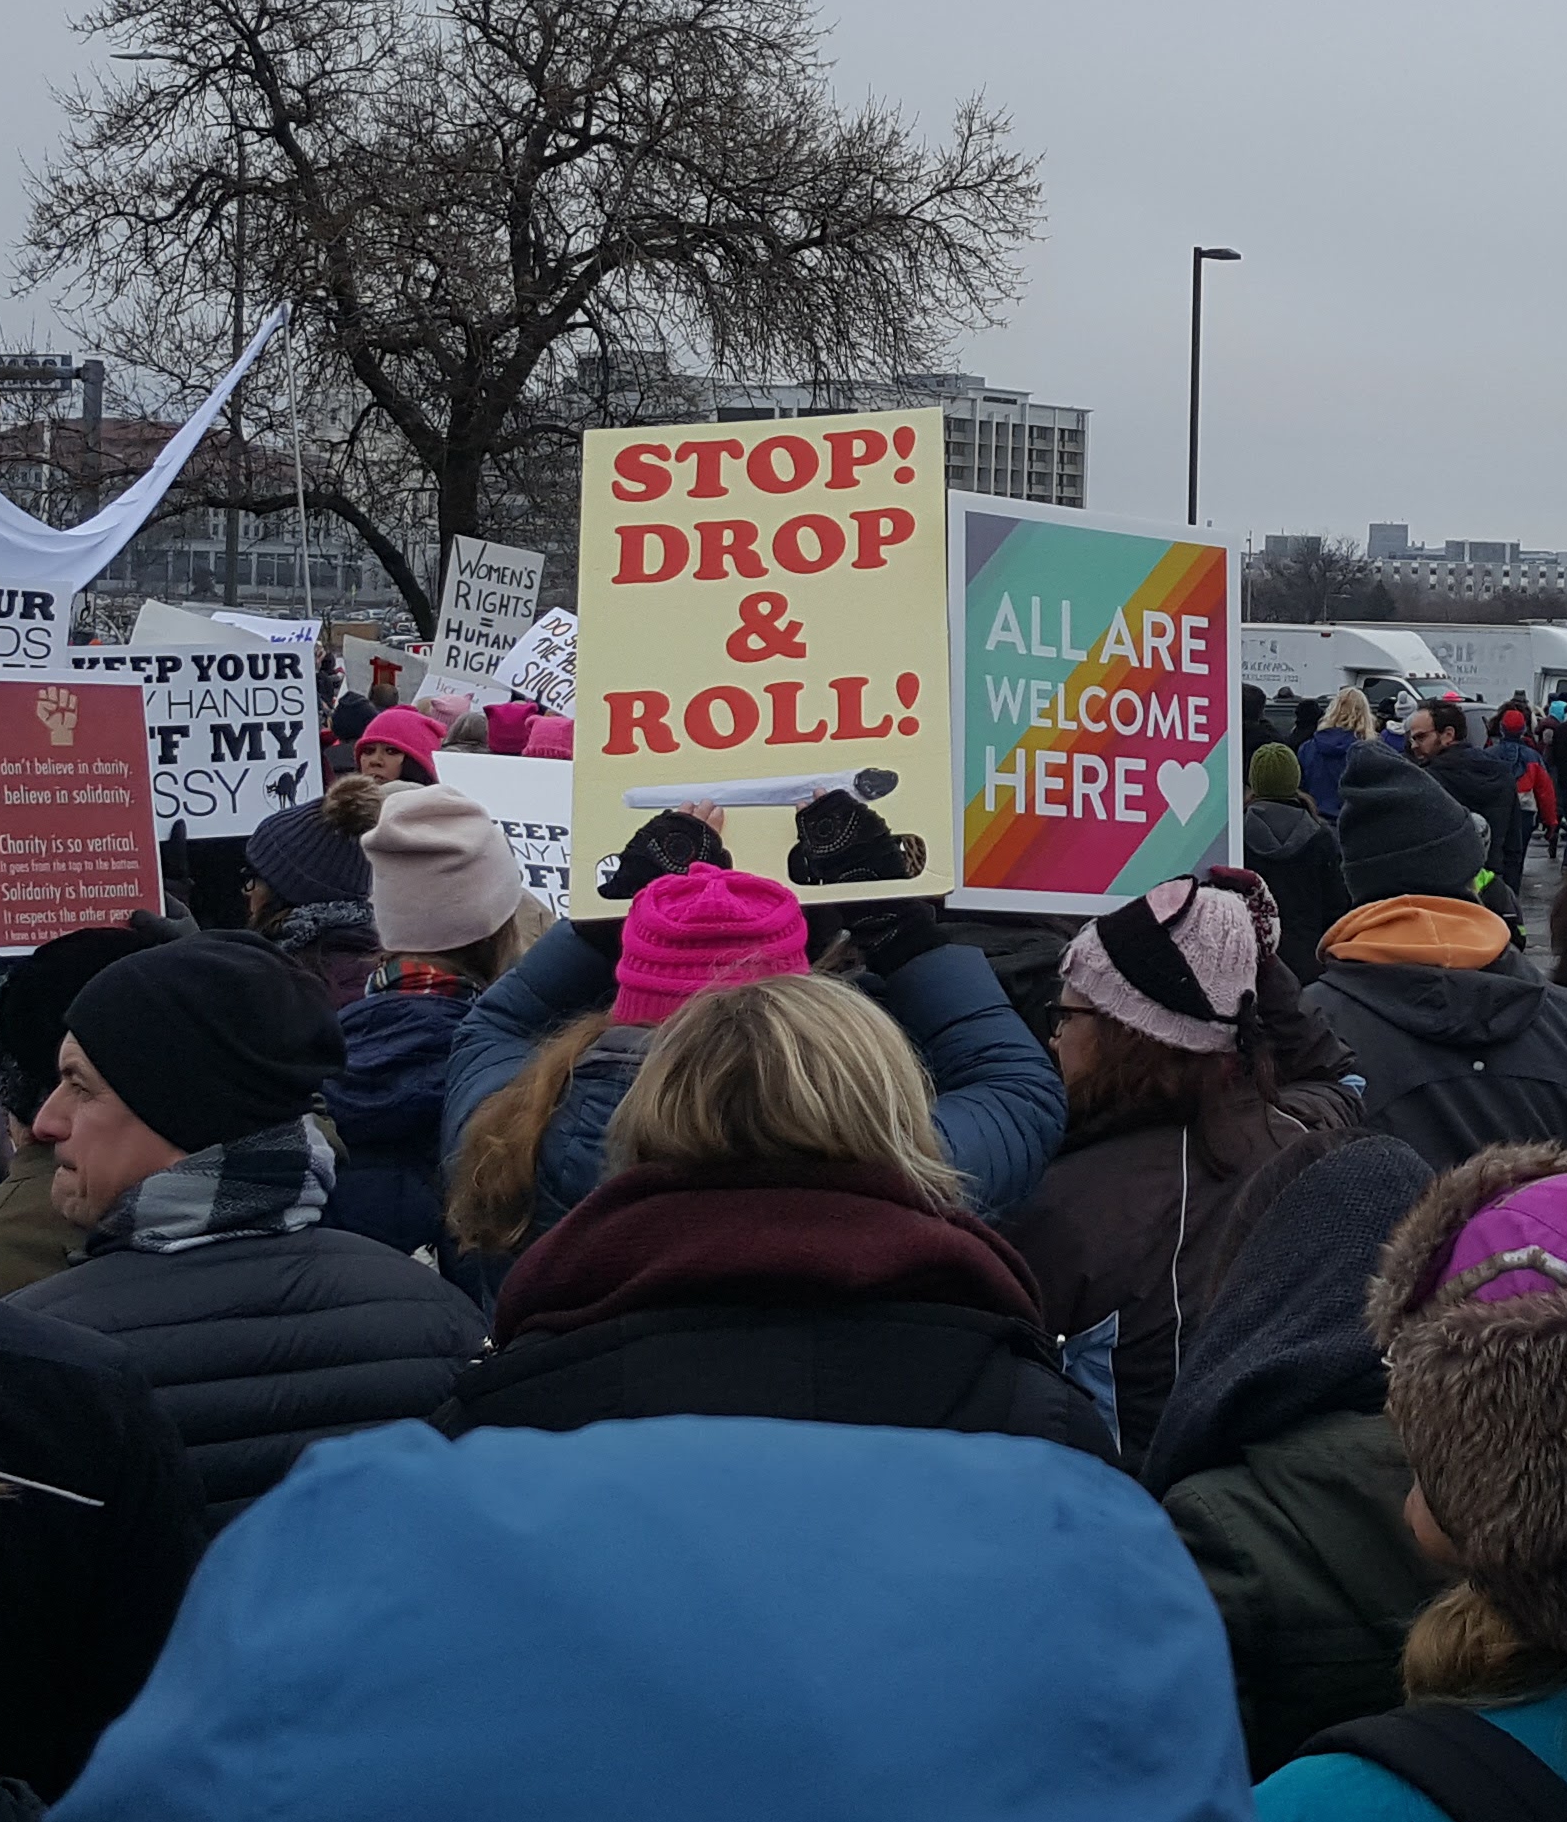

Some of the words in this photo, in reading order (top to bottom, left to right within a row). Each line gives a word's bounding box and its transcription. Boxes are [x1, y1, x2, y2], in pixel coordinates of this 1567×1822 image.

[612, 426, 916, 502] STOP!
[612, 507, 915, 584] DROP
[454, 536, 537, 590] WOMEN'S
[454, 579, 533, 618] RIGHTS
[445, 617, 517, 650] HUMAN
[540, 616, 573, 638] DO
[725, 591, 807, 663] &
[985, 591, 1087, 661] ALL
[1099, 606, 1209, 675] ARE
[445, 645, 505, 676] RIGH
[532, 637, 566, 663] THE
[191, 653, 304, 682] YOUR
[168, 686, 305, 719] HANDS
[601, 671, 920, 755] ROLL!
[985, 674, 1209, 742] WELCOME
[210, 721, 304, 763] MY
[0, 757, 32, 775] don't
[34, 757, 74, 775] believe
[78, 759, 90, 774] in
[92, 757, 133, 779] charity.
[985, 745, 1147, 823] HERE
[4, 784, 52, 805] believe
[56, 786, 69, 804] in
[72, 783, 135, 808] solidarity.
[153, 767, 250, 819] SSY
[51, 834, 64, 853] is
[67, 838, 82, 853] so
[86, 831, 139, 853] vertical.
[491, 819, 570, 842] EEP
[9, 863, 30, 875] goes
[31, 859, 51, 872] from
[53, 859, 67, 872] the
[68, 861, 83, 873] top
[84, 861, 94, 871] to
[95, 858, 110, 870] the
[1, 882, 61, 904] Solidarity
[65, 883, 76, 899] is
[79, 879, 143, 899] horizontal.
[3, 909, 12, 924] It
[15, 910, 57, 927] respects
[60, 907, 76, 923] the
[79, 906, 106, 921] other
[109, 908, 134, 924] pers
